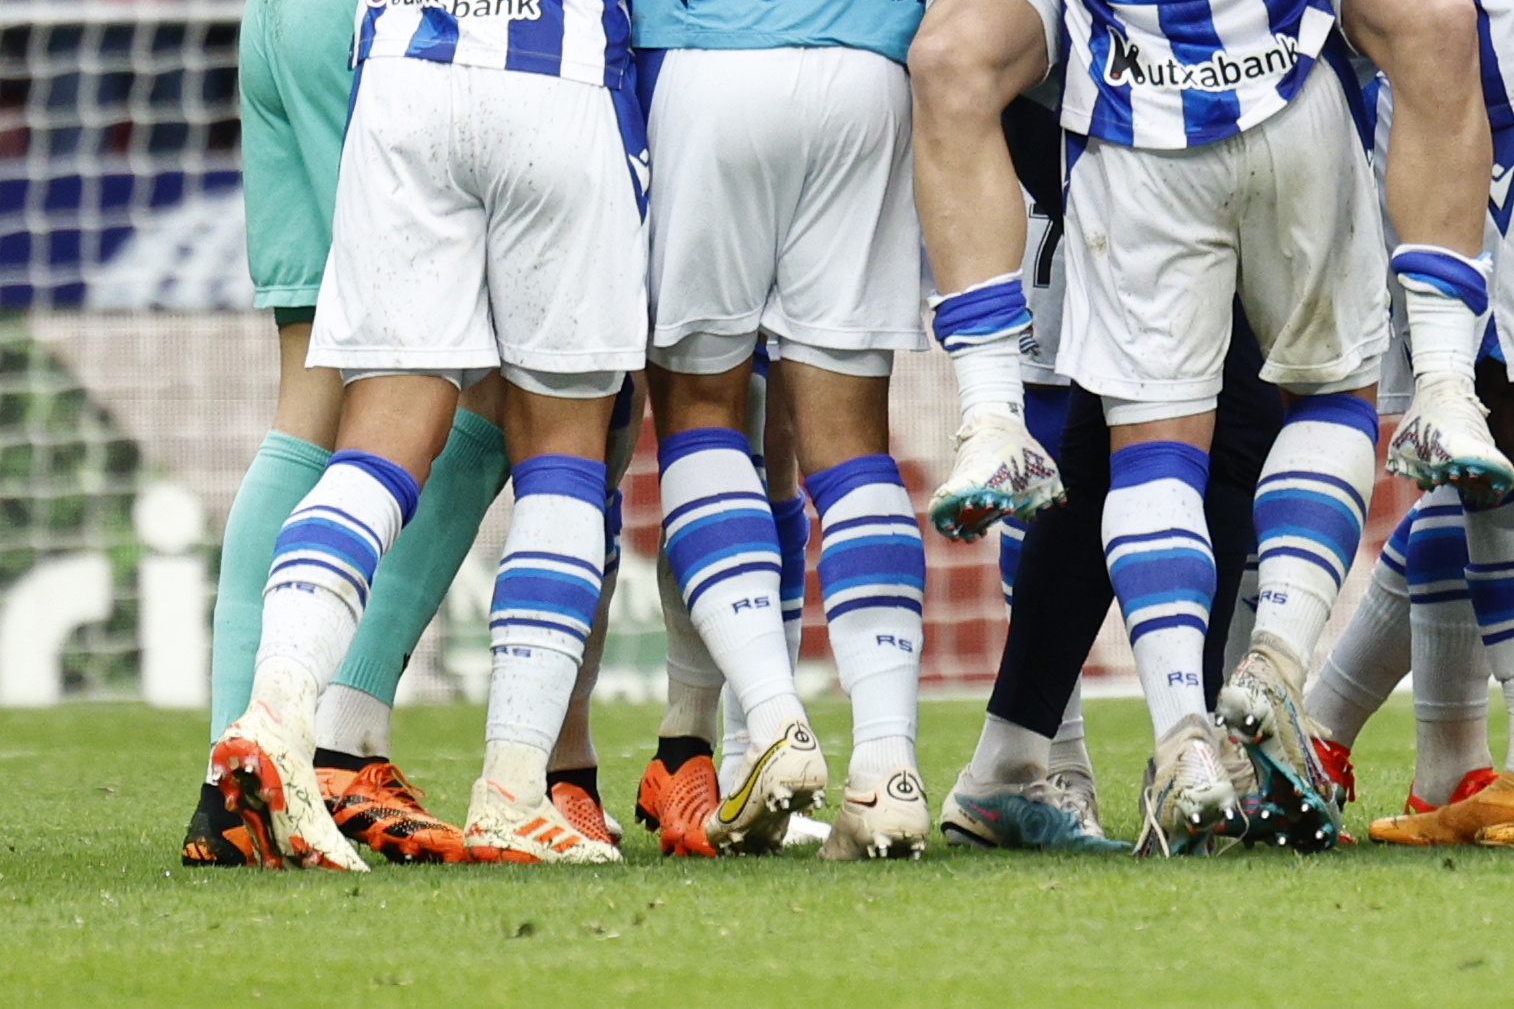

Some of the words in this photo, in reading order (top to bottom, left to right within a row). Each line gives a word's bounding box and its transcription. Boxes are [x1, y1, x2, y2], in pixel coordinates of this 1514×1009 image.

[1108, 27, 1297, 86] Kutxabank
[732, 595, 770, 614] RS
[876, 634, 913, 653] RS
[1167, 671, 1199, 686] RS
